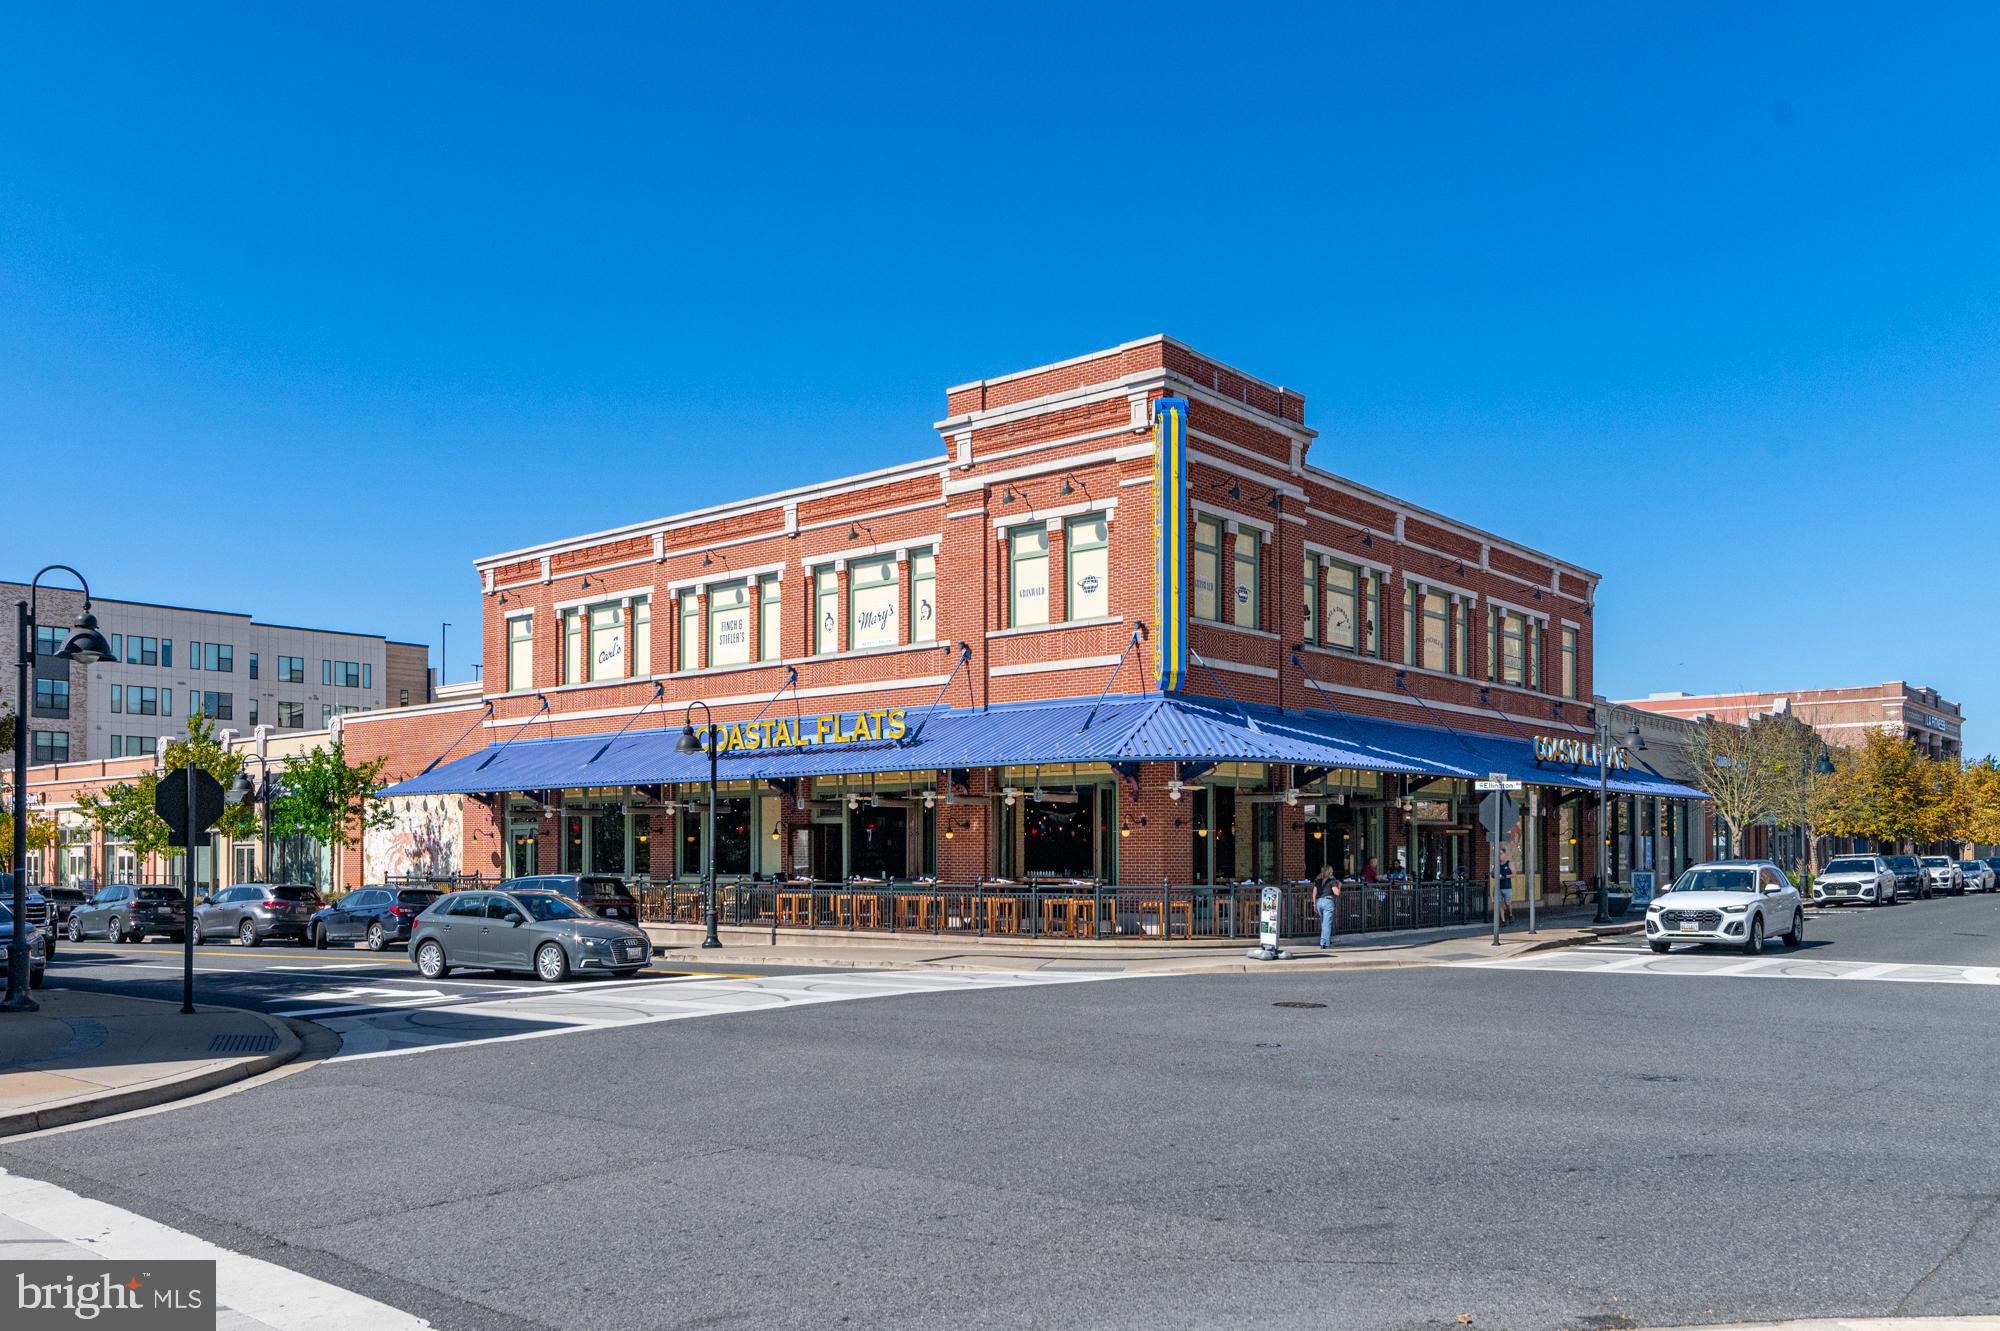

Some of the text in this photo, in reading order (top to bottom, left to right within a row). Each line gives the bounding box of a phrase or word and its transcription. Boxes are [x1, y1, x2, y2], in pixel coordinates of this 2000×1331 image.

[721, 619, 738, 632] FINCH
[858, 603, 895, 631] Mary's
[719, 631, 745, 646] STIFLER'S
[598, 642, 622, 664] Carl's
[695, 708, 907, 753] COASTAL FLATS
[1534, 735, 1630, 771] COASTAL FATS
